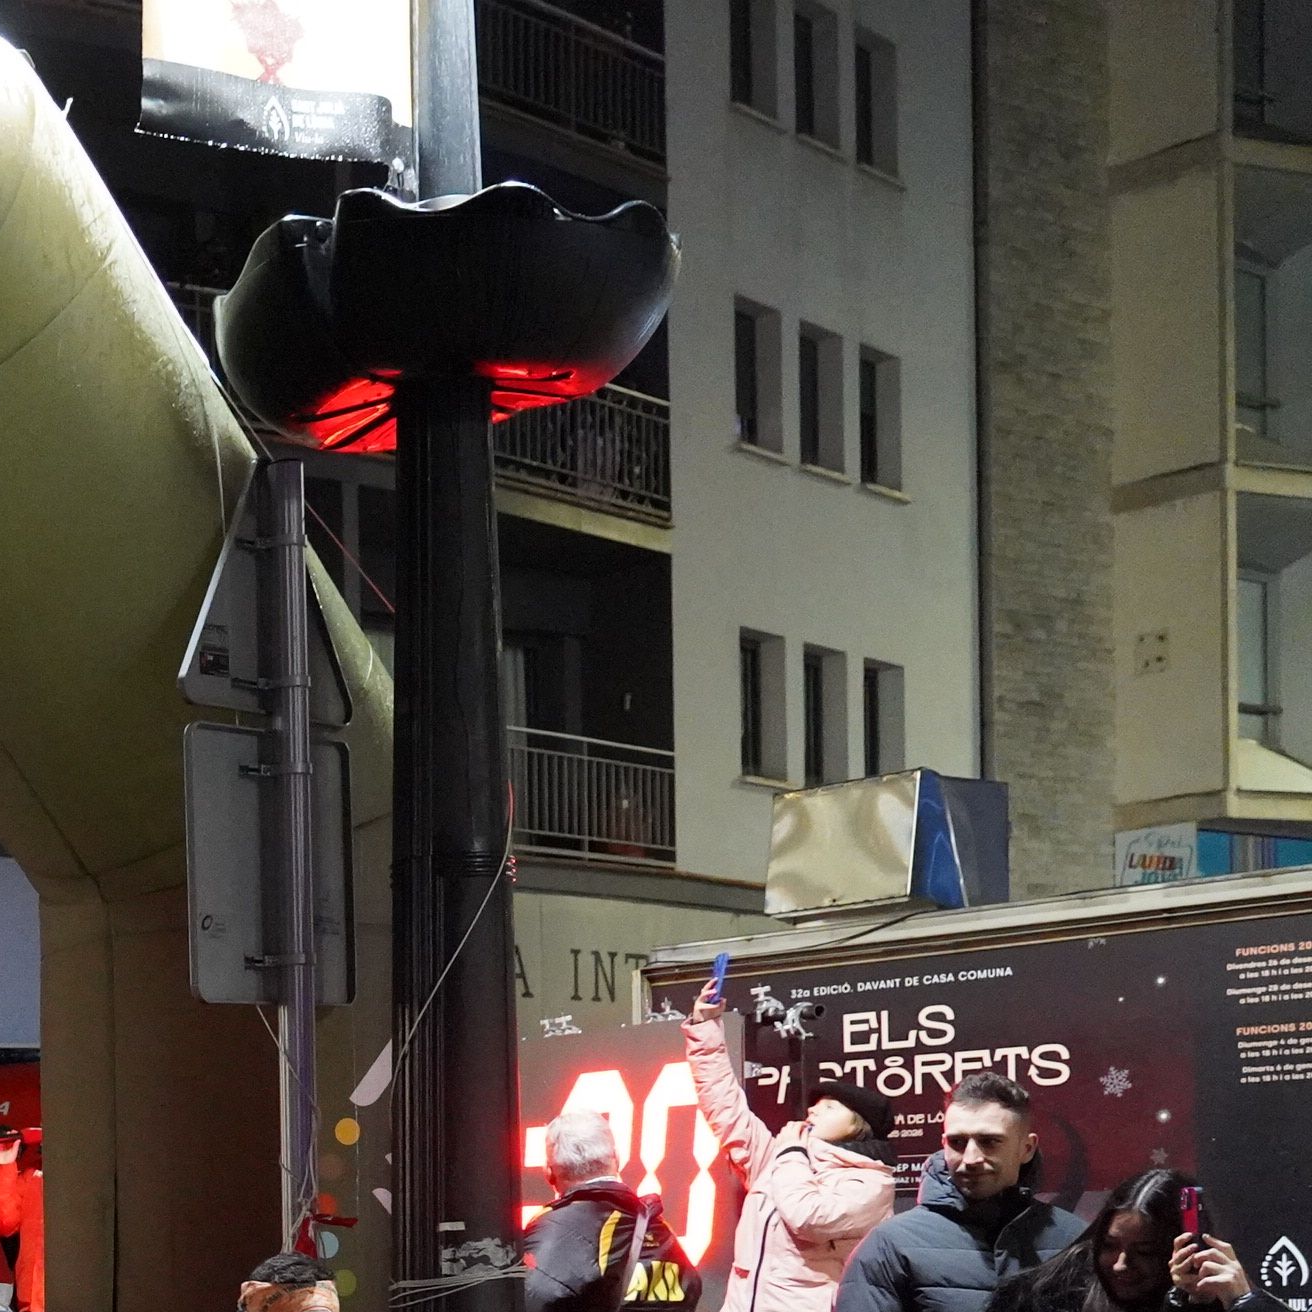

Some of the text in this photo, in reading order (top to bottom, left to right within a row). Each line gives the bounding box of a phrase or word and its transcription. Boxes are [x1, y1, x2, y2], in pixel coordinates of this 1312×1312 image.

[1236, 943, 1295, 957] FUNCIONS
[857, 978, 901, 992] DAVANT
[904, 977, 920, 987] DE
[923, 972, 955, 985] CASA
[958, 966, 1013, 981] COMUNA
[842, 1004, 956, 1053] ELS
[1236, 1022, 1296, 1036] FUNCIONS
